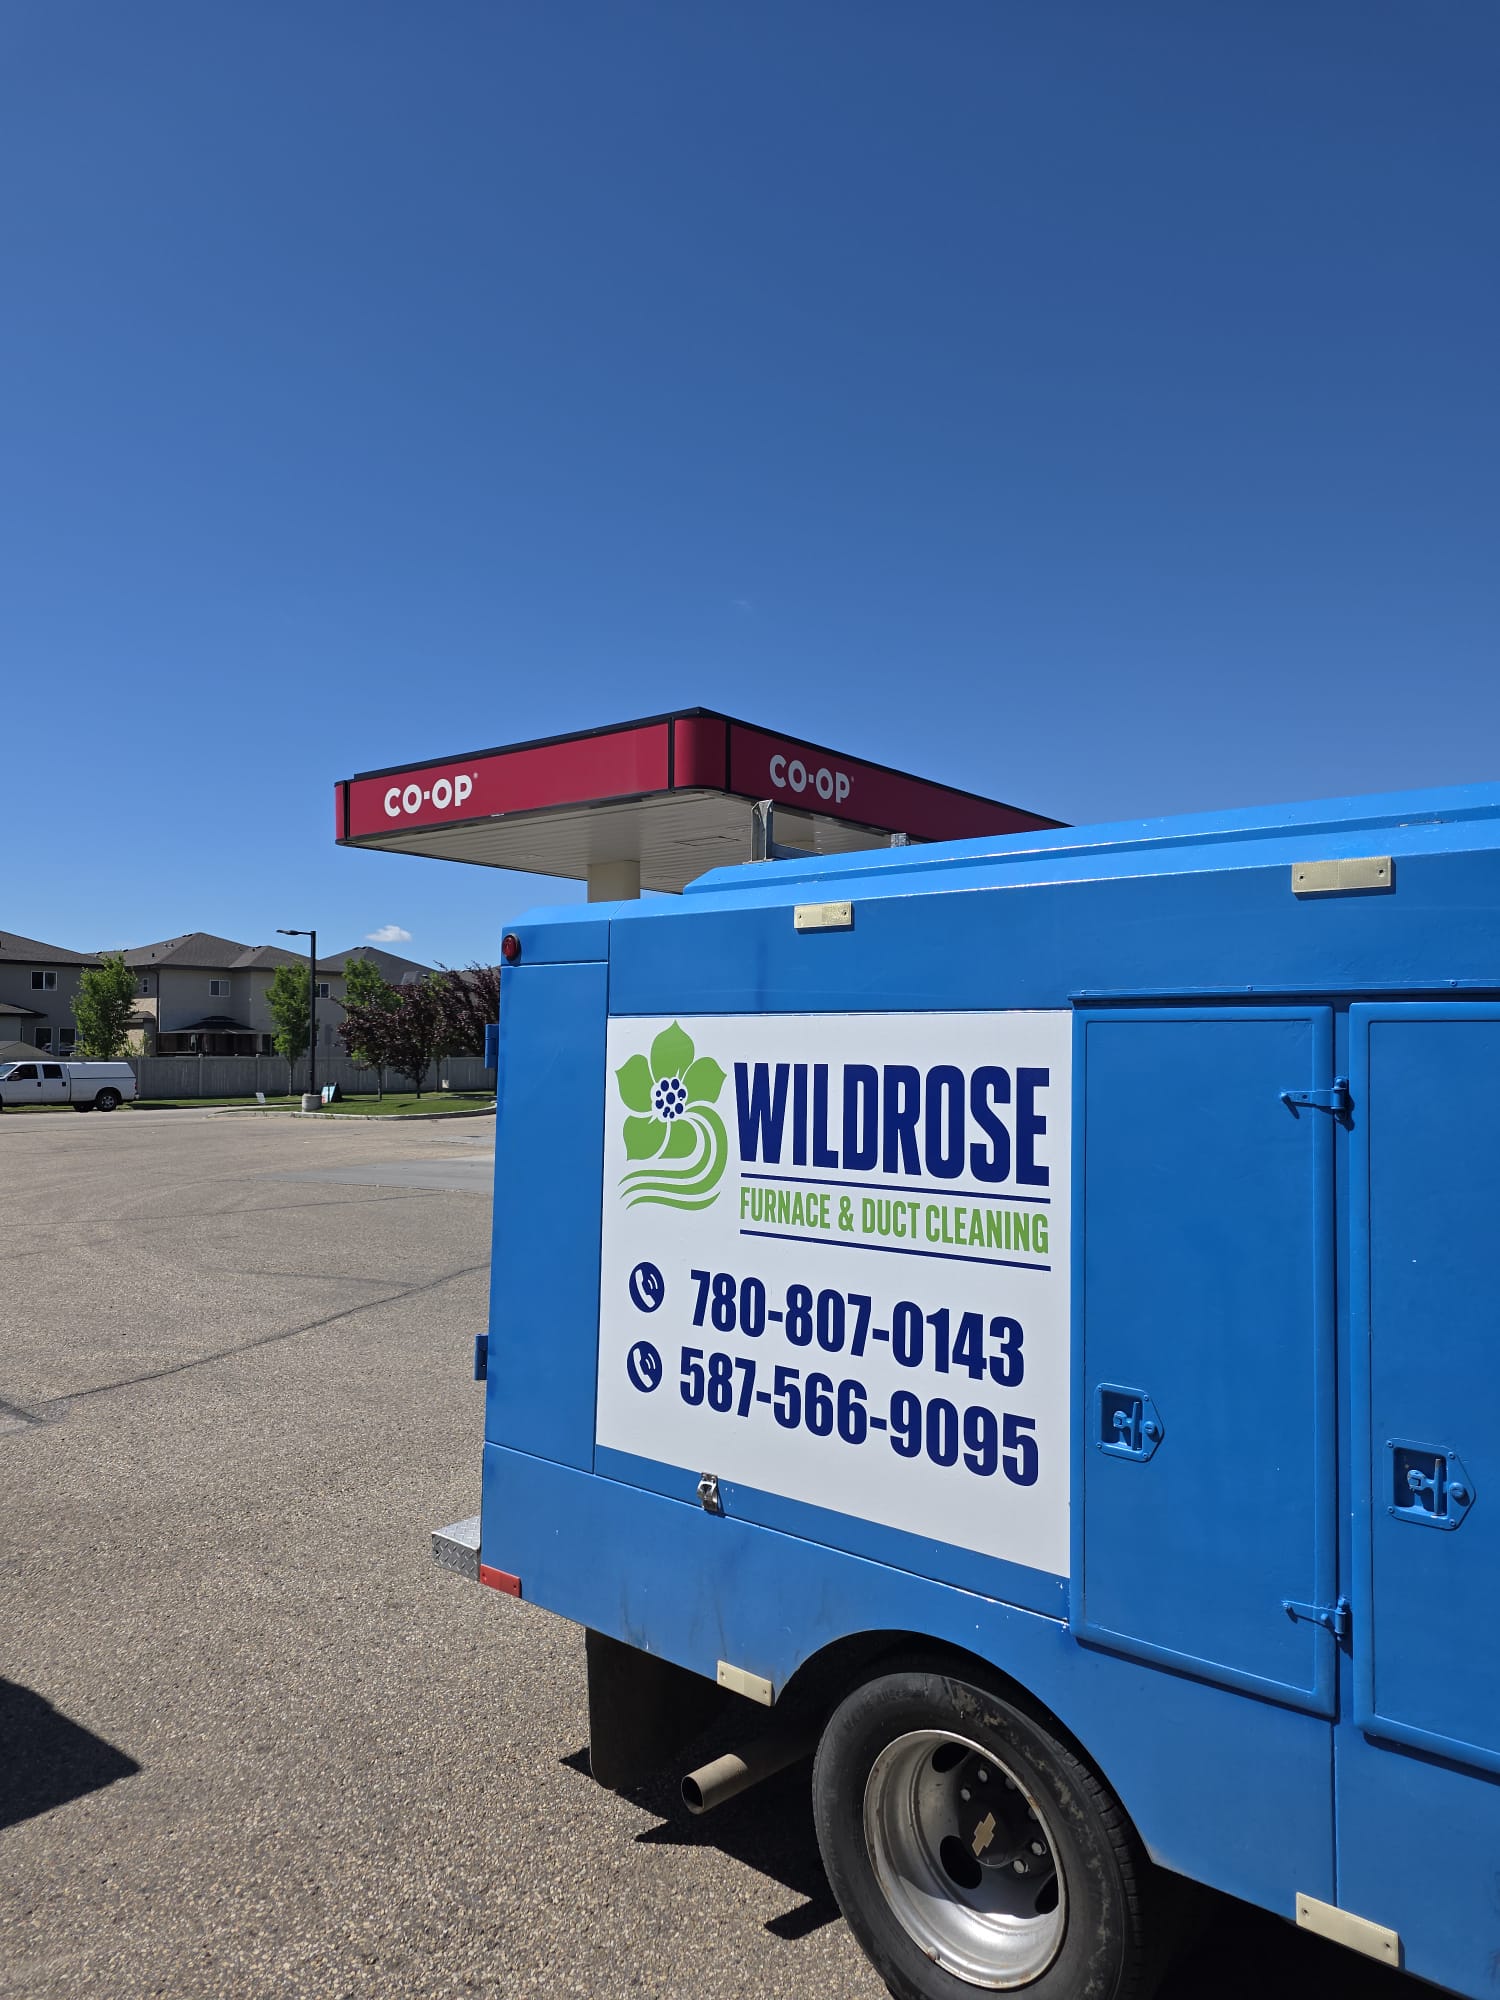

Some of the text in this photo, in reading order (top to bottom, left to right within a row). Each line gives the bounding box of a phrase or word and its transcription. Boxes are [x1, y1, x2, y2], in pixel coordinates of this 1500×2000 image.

[384, 774, 473, 817] CO-OP
[769, 754, 850, 804] CO-OP
[733, 1062, 1050, 1187] WILDROSE
[740, 1186, 1049, 1254] FURNACE & DUCT CLEANING
[690, 1269, 1025, 1388] 780-807-0143
[680, 1346, 1039, 1487] 587-566-9095
